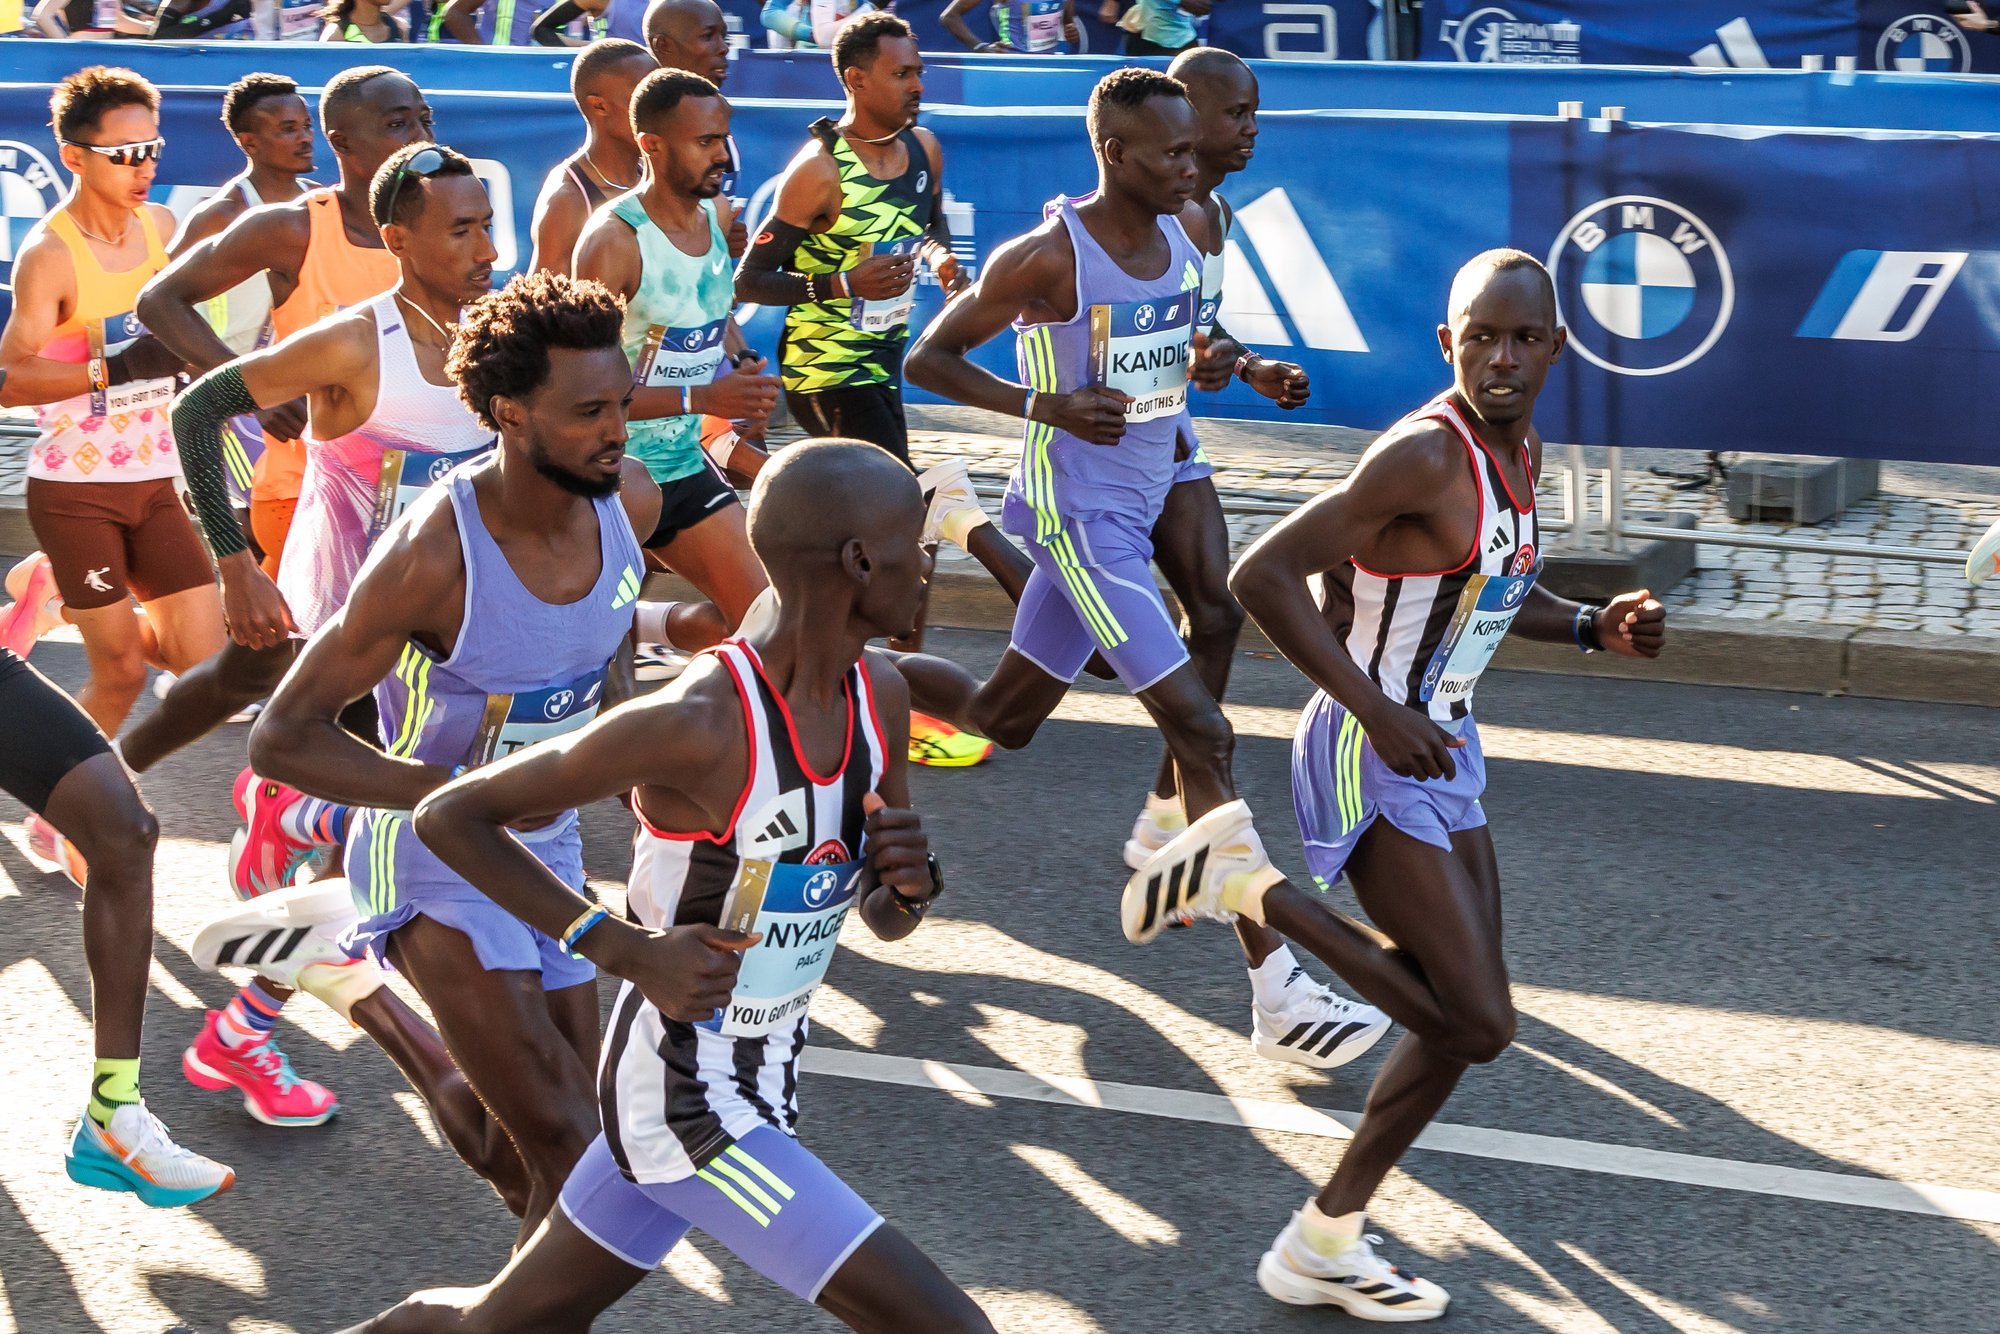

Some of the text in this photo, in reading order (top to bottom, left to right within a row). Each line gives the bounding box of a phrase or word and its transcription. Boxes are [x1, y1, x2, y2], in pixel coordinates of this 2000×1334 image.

[1502, 22, 1548, 38] BMW
[1502, 40, 1553, 51] BERLIN
[1112, 341, 1187, 373] KANDIE
[1136, 400, 1153, 414] GOT
[1154, 396, 1174, 409] THIS
[1440, 679, 1461, 693] YOU
[795, 949, 824, 970] PACE
[732, 989, 812, 1026] YOU GOT THIS
